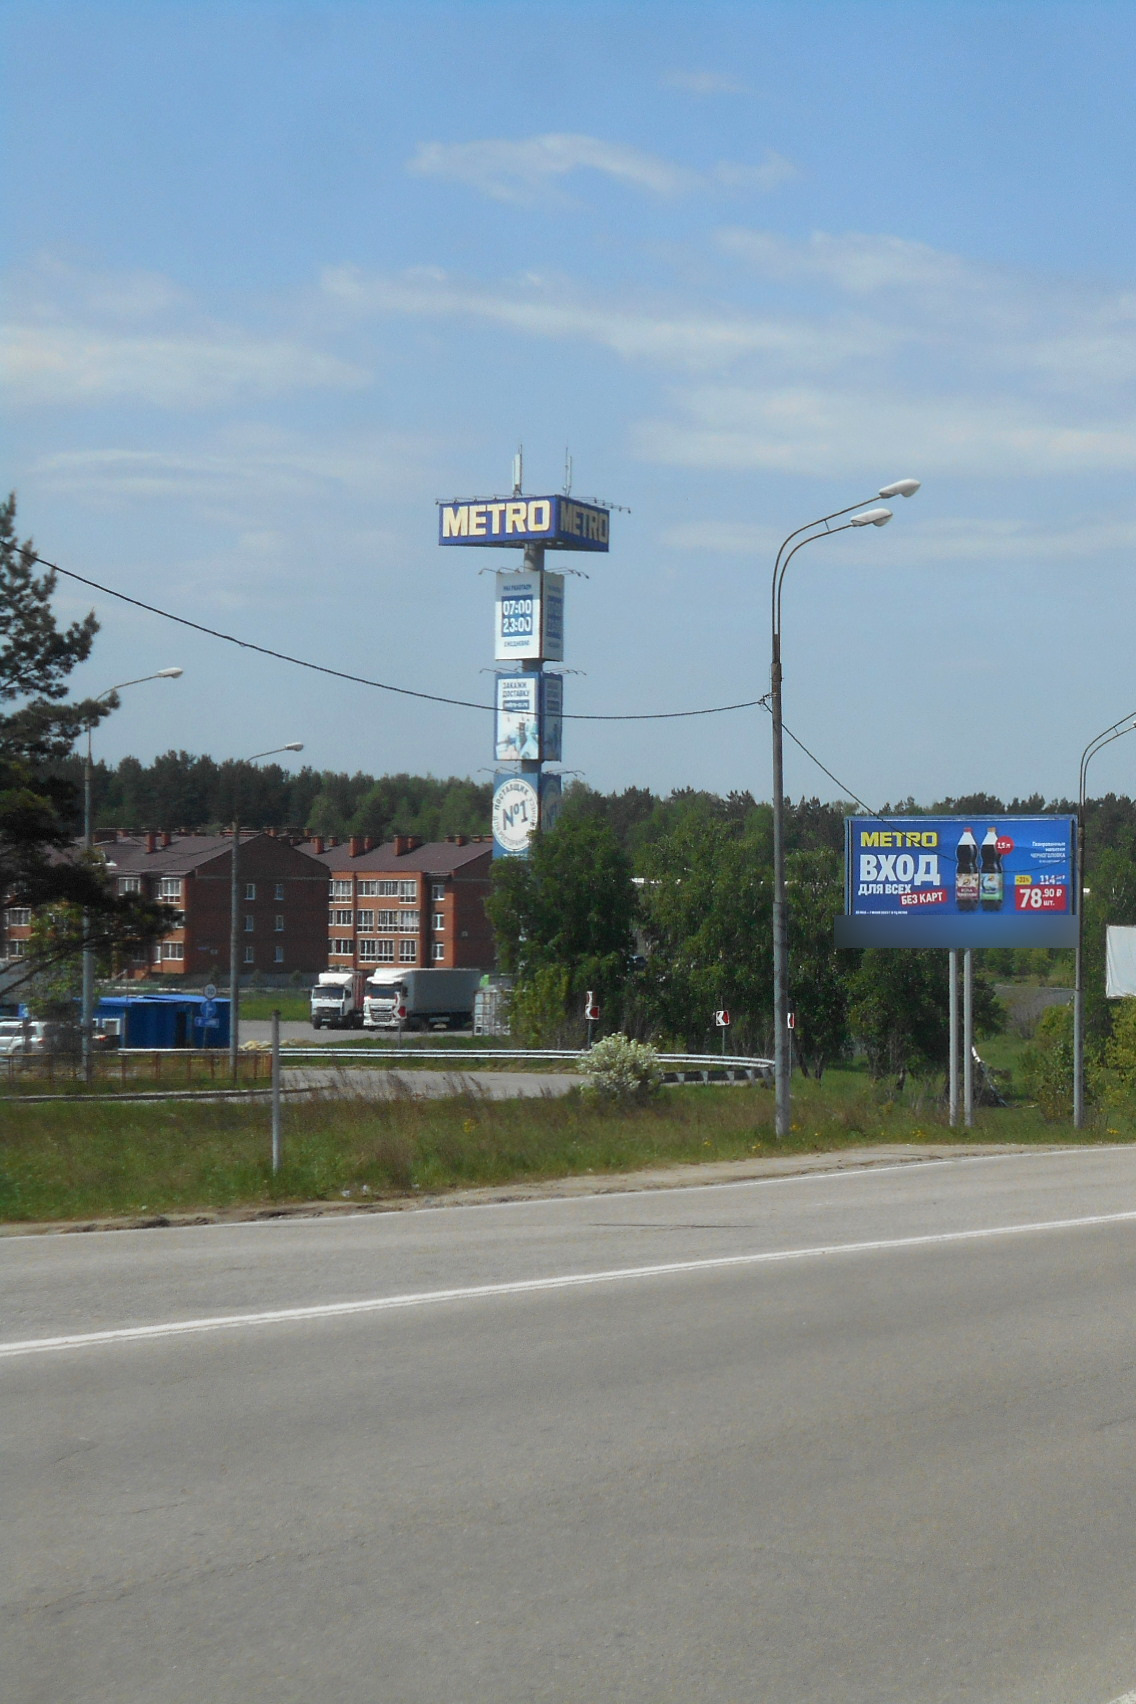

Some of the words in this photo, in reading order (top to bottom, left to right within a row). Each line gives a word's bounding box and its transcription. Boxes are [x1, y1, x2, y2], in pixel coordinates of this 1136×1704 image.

[442, 499, 550, 538] METRO
[560, 500, 608, 544] METRO
[503, 600, 532, 615] 07:00
[503, 617, 531, 632] 23:00
[494, 783, 529, 811] ПОСТАВЩИК
[860, 832, 938, 847] METRO
[860, 854, 941, 886] ВХОД
[858, 884, 884, 896] ДЛЯ
[885, 884, 912, 895] ВСЕХ
[901, 894, 918, 905] БЕЗ
[919, 892, 943, 903] КАРТ
[1020, 888, 1043, 908] 78
